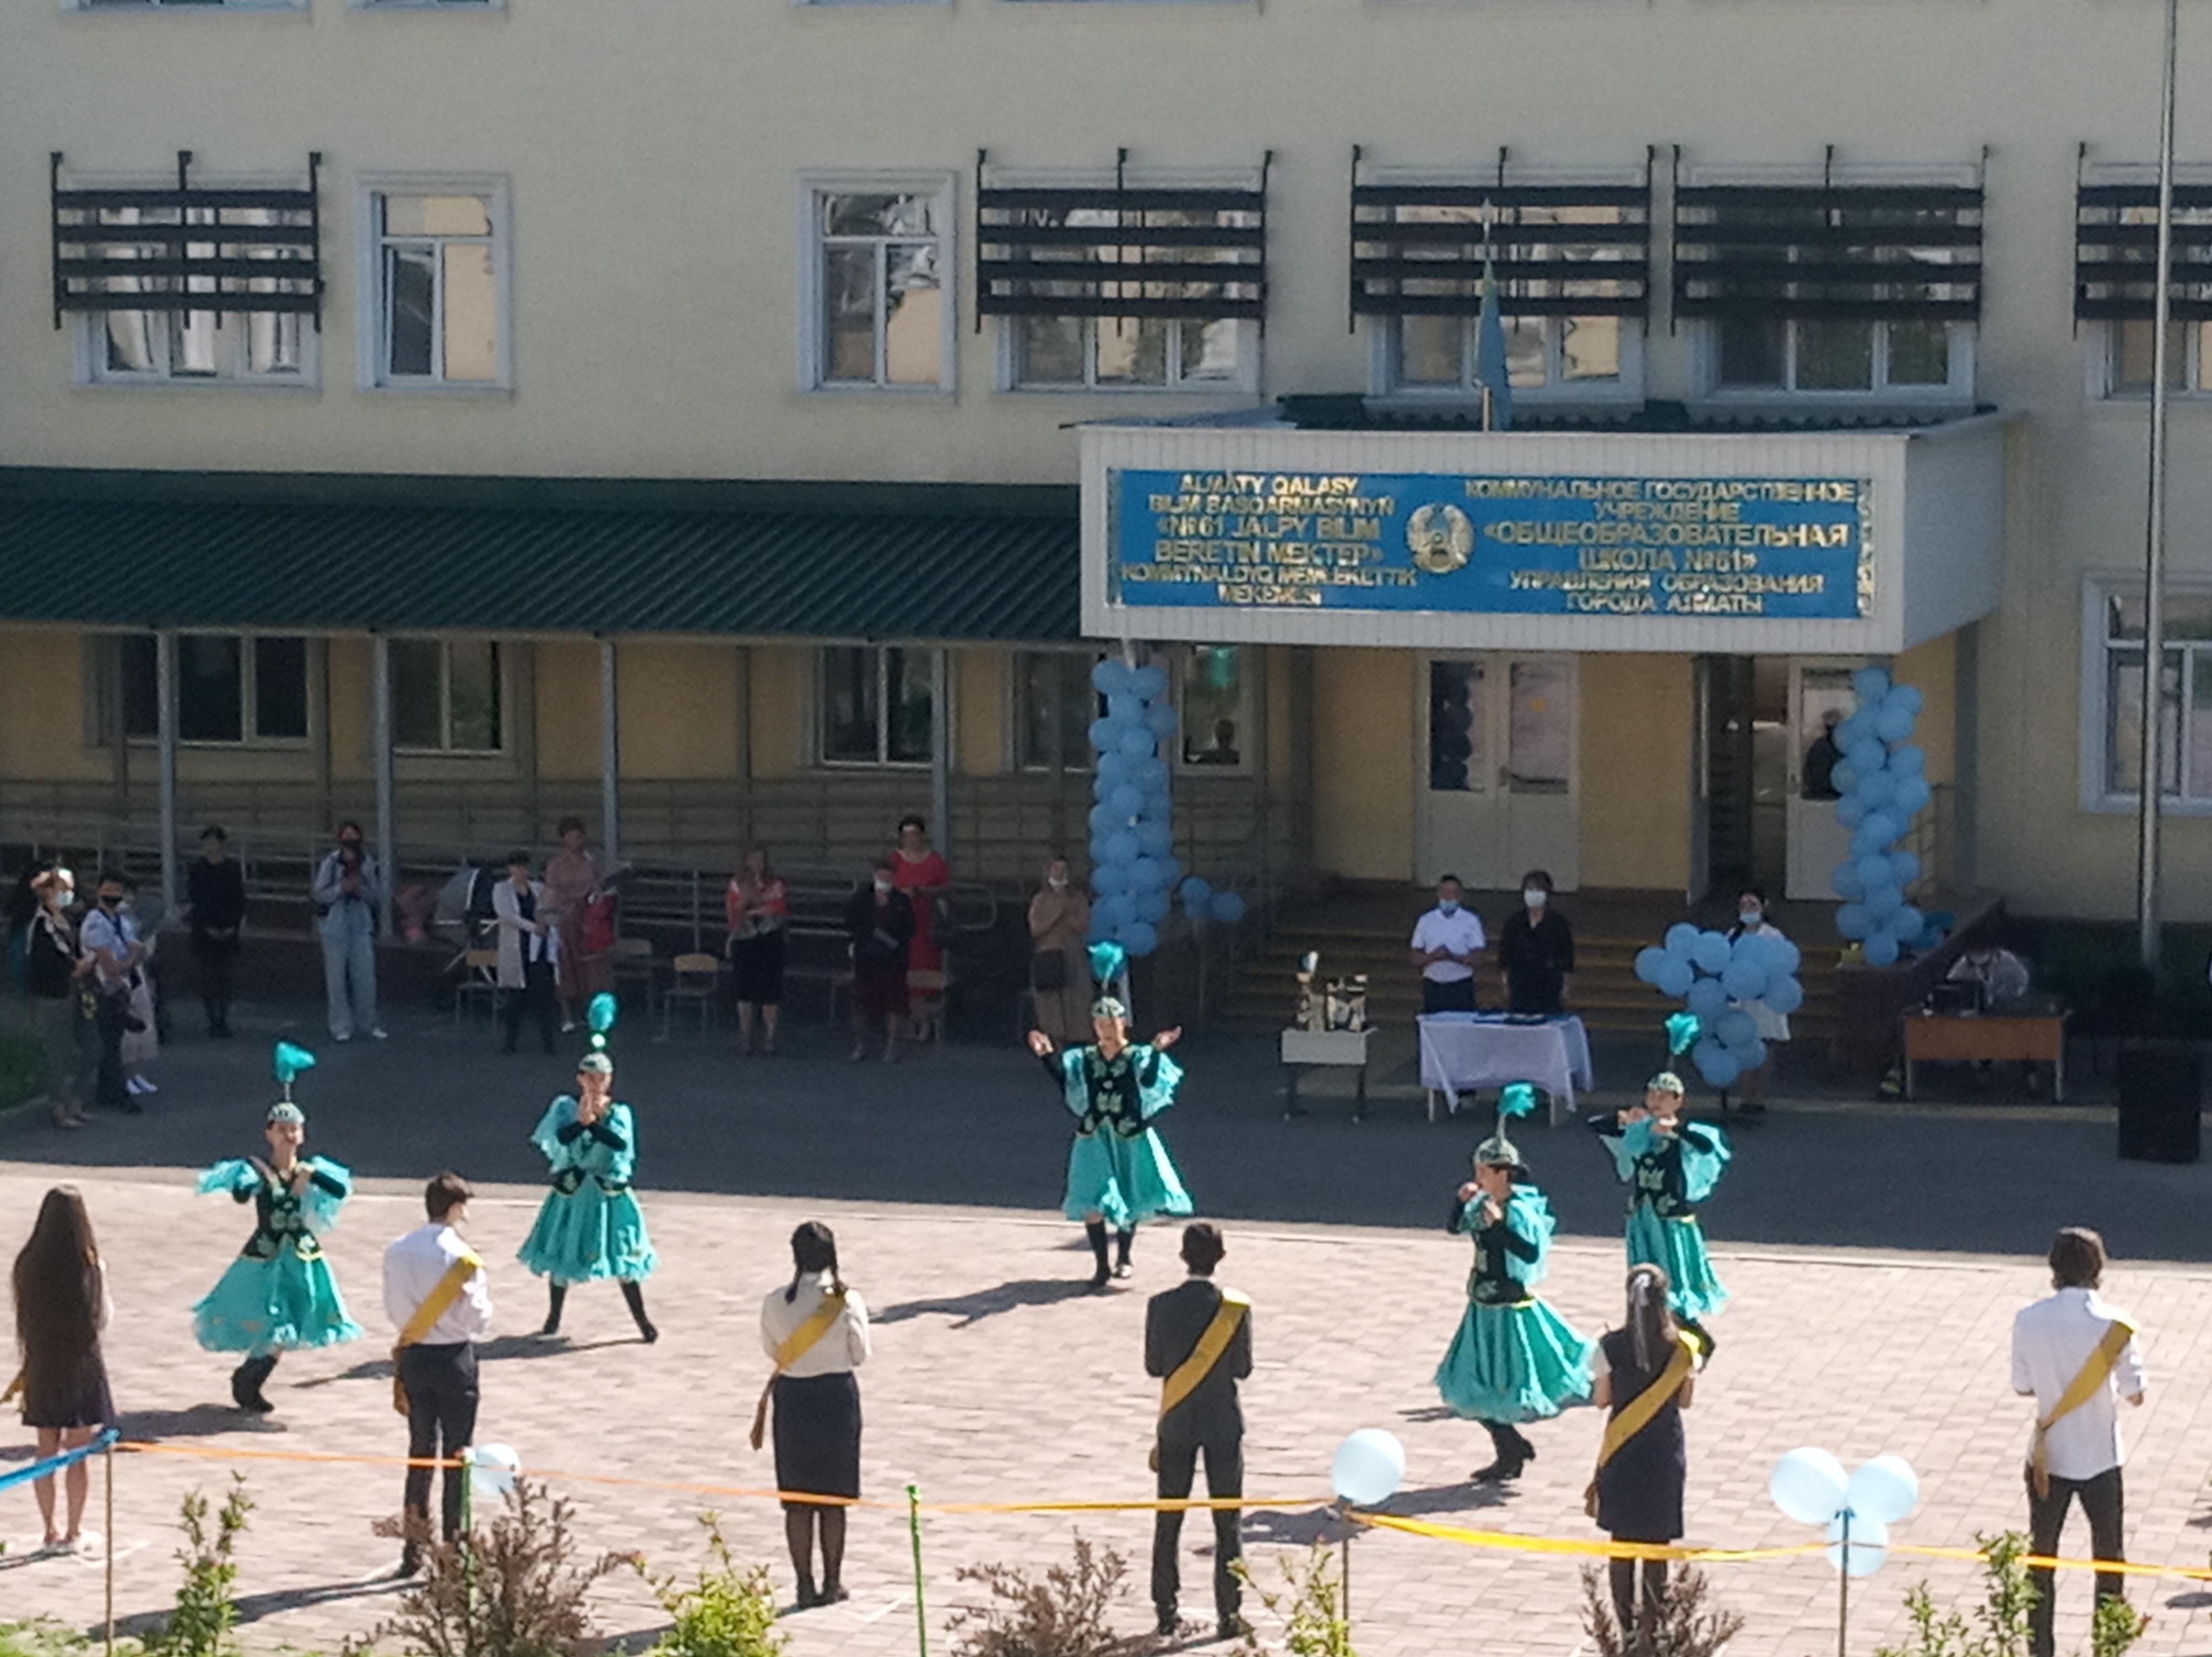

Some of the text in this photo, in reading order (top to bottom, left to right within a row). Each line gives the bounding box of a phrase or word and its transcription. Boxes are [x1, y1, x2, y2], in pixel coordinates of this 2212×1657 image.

[1272, 475, 1358, 495] QALASY
[1465, 479, 1856, 502] КОММУНАЛЬНОЕ ГОСУДАРСТВЕННОЕ
[1595, 501, 1740, 522] УЧРЕЖДЕНИЕ
[1230, 516, 1309, 539] JALPY
[1483, 521, 1848, 547] «ОБЩЕОБРАЗОВАТЕЛЬНАЯ
[1156, 539, 1260, 563] BERETIN
[1579, 547, 1676, 571] ШКОЛА
[1509, 571, 1824, 593] УПРАВЛЕНИЯ ОБРАЗОВАНИЯ
[1567, 592, 1763, 613] ГОРОДА АЛМАТЫ
